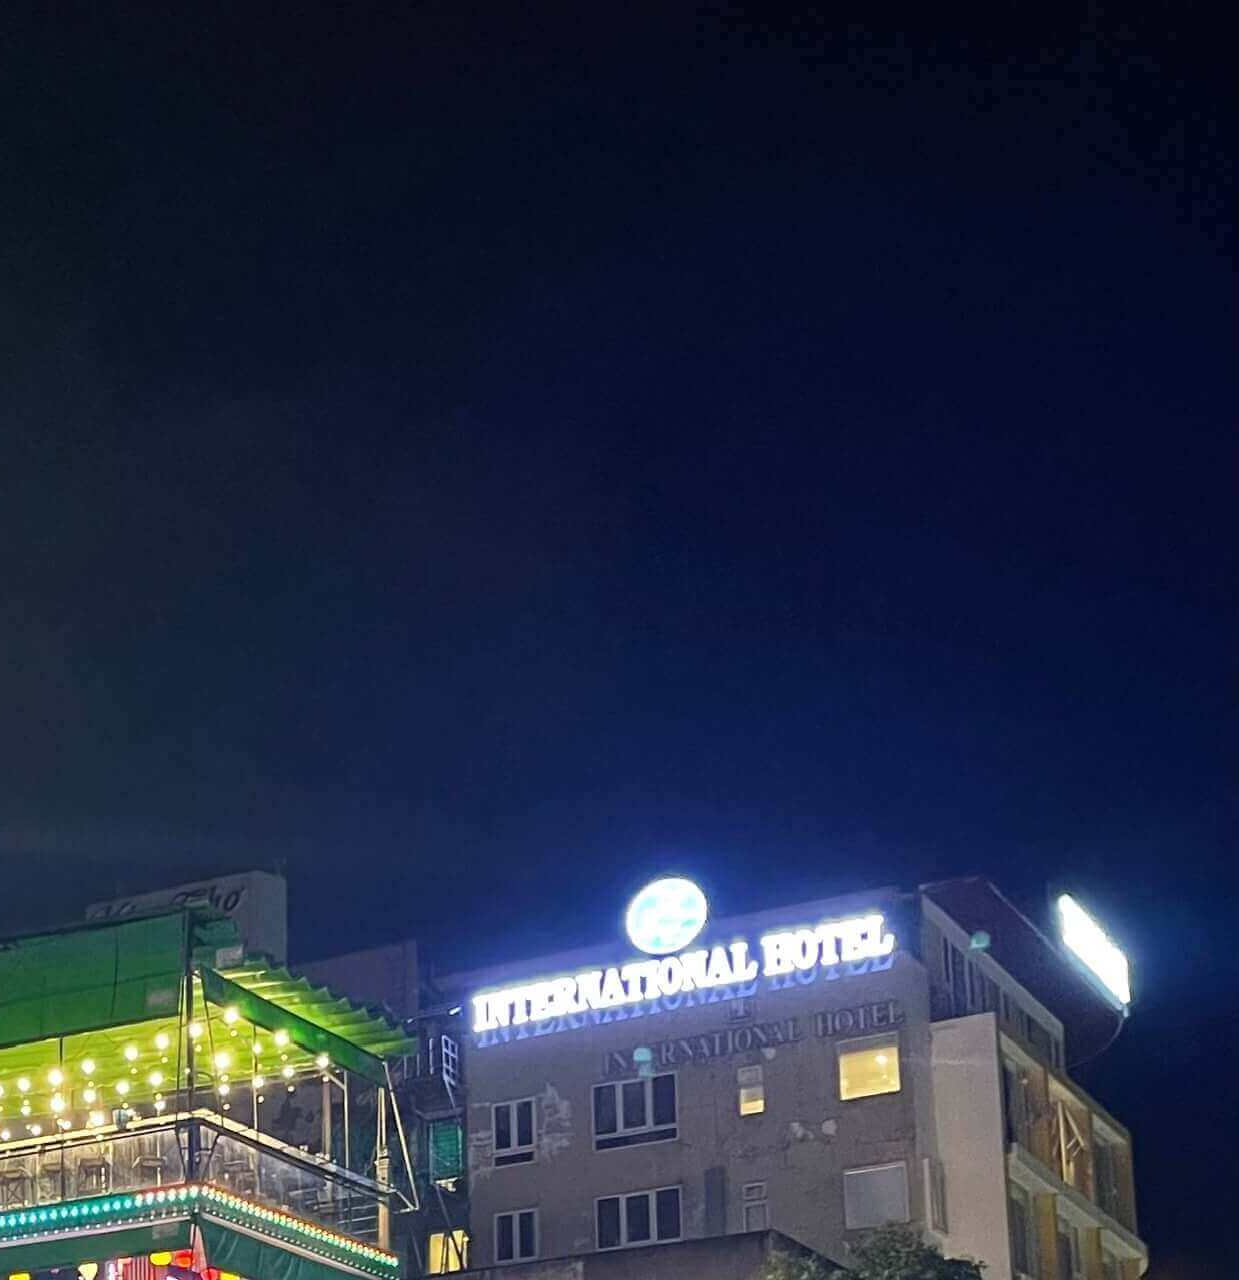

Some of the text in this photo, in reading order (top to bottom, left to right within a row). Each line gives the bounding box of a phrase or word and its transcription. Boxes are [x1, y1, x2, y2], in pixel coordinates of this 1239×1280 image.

[473, 914, 894, 1032] INTERNATIONAL HOTEL
[814, 999, 905, 1037] HOTEL
